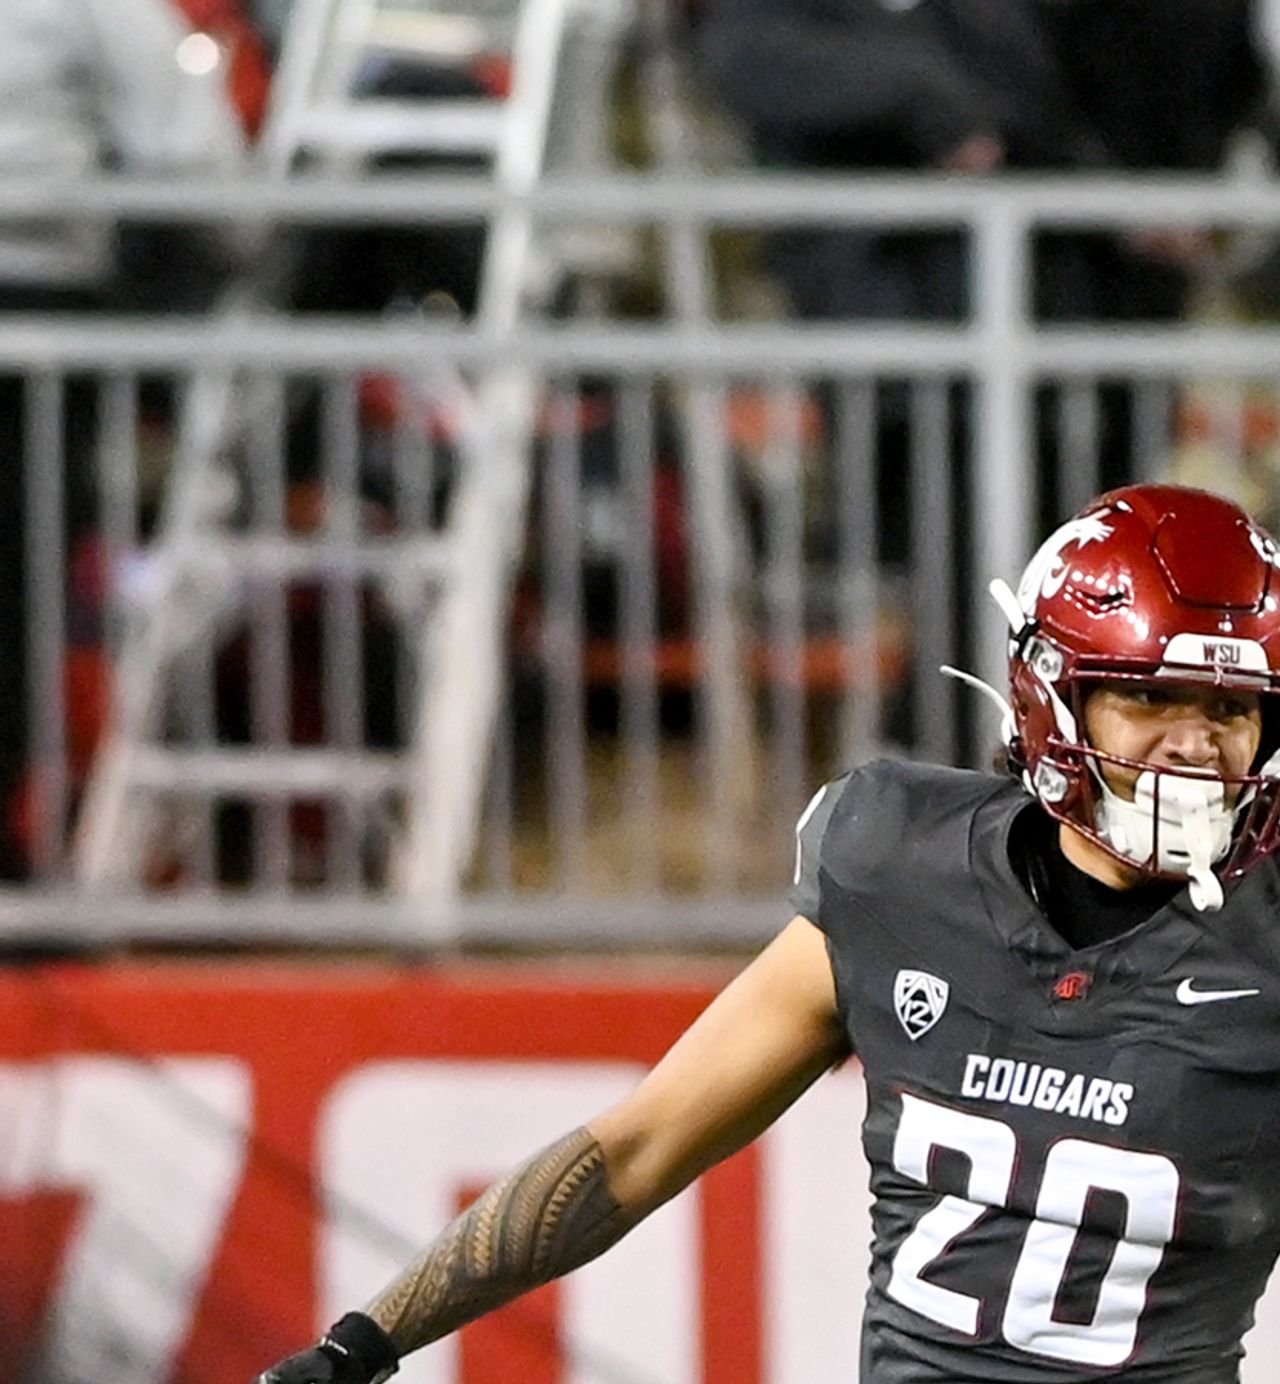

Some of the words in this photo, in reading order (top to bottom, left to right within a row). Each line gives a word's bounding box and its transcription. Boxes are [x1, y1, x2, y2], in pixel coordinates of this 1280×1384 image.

[1202, 642, 1241, 664] WSU
[960, 1054, 1135, 1126] COUGARS
[887, 1093, 1182, 1369] 20
